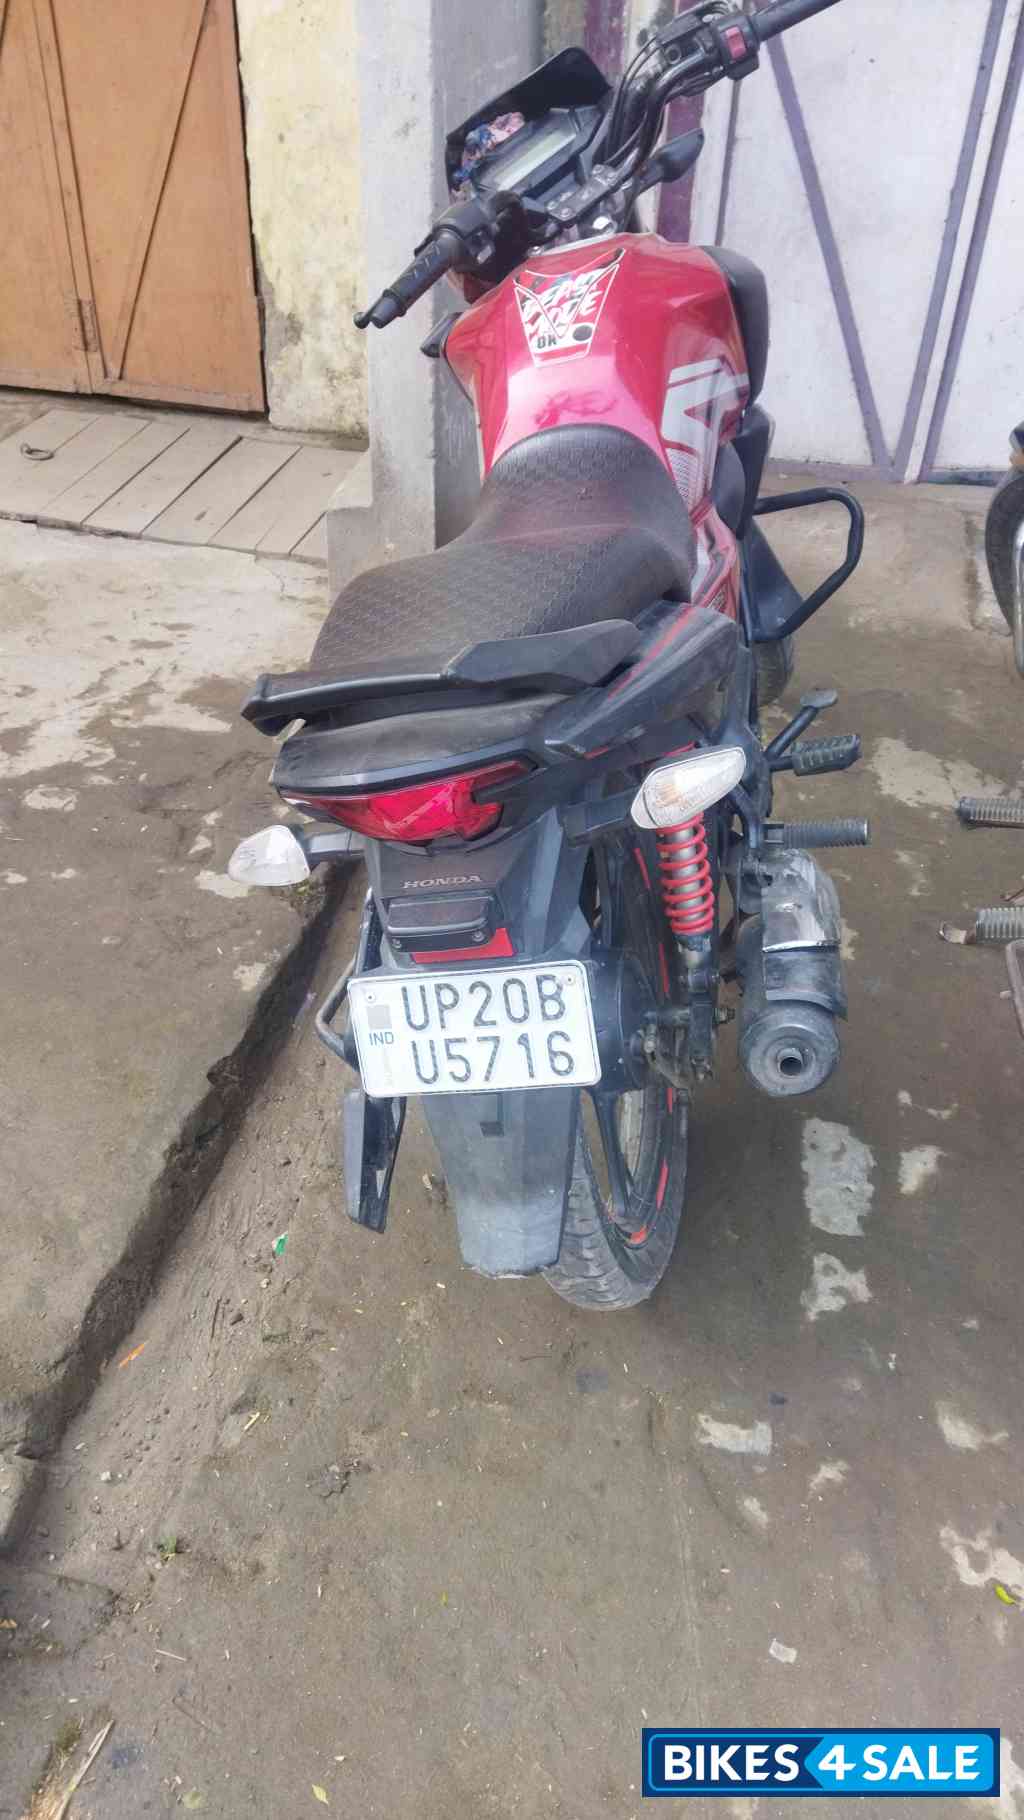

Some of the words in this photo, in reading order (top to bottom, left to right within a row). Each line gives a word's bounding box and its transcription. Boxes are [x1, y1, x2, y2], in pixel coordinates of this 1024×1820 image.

[402, 875, 482, 889] HONDA
[401, 974, 566, 1031] UP20B
[369, 1031, 394, 1046] IND
[411, 1030, 575, 1084] U5716
